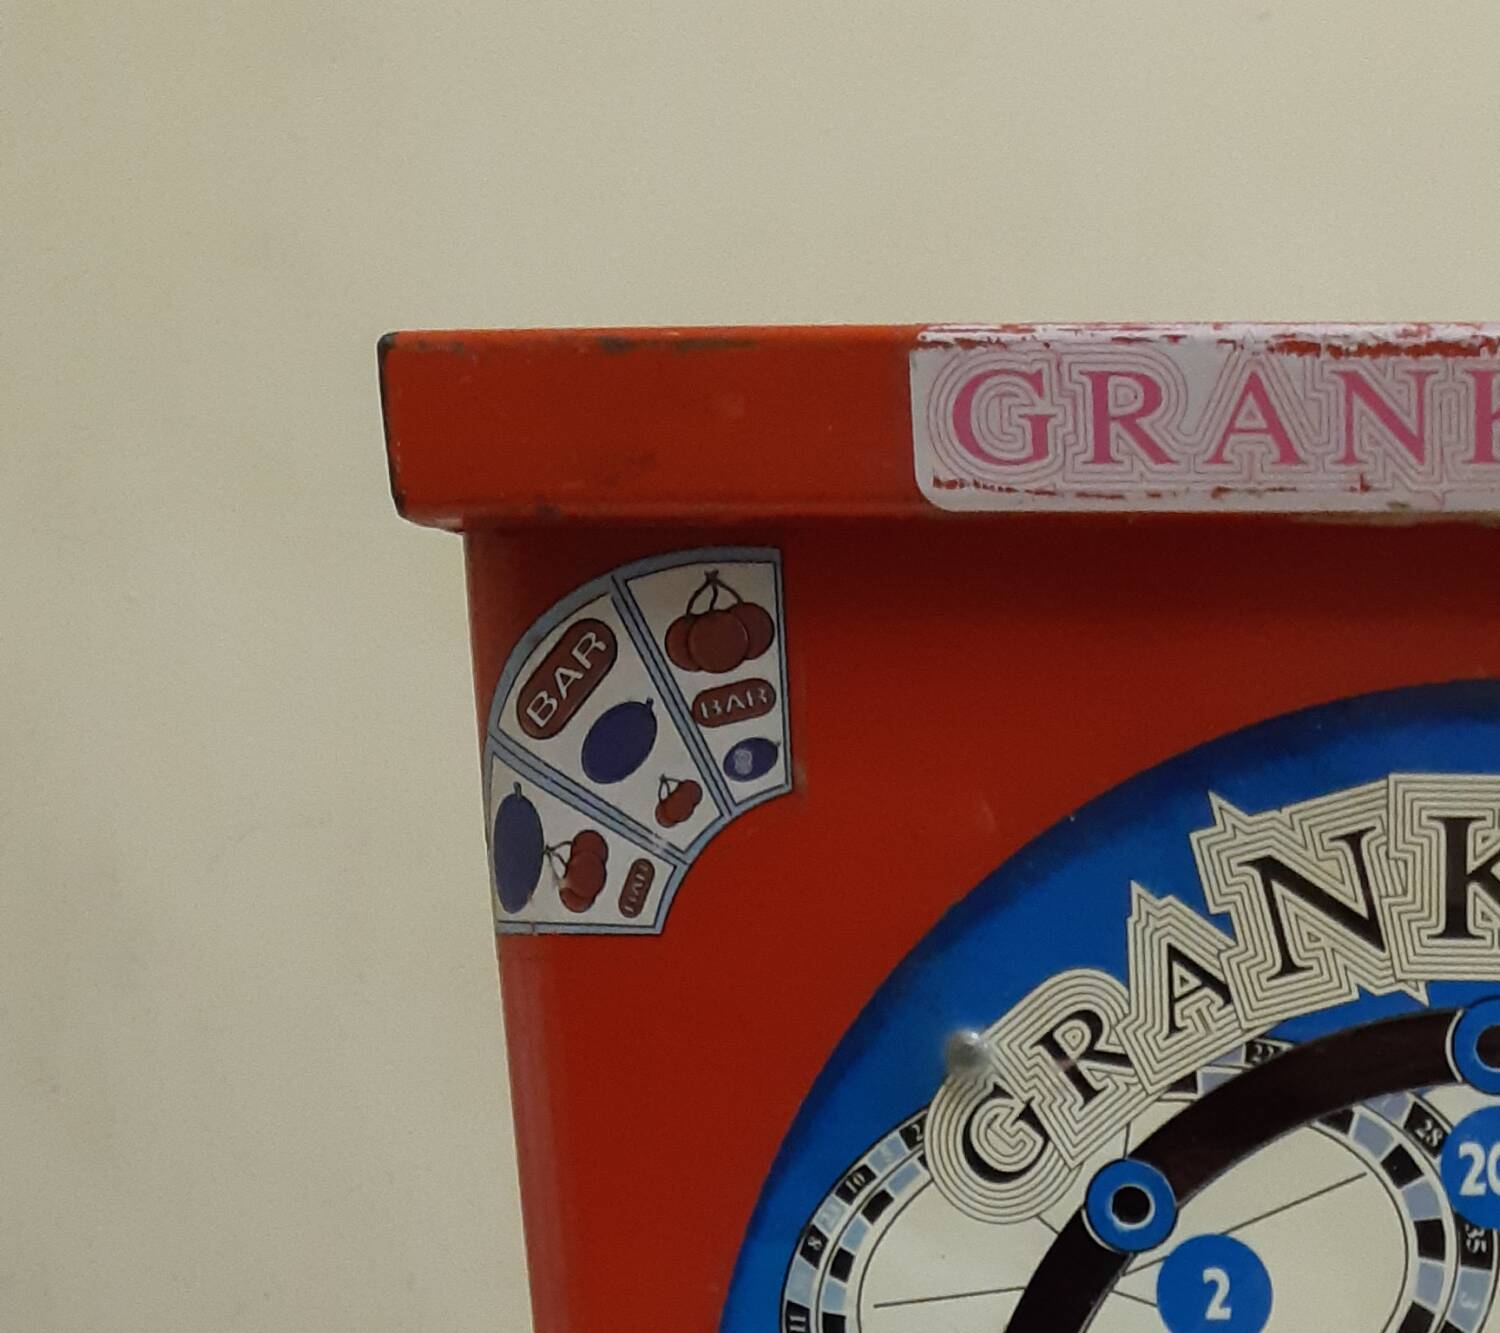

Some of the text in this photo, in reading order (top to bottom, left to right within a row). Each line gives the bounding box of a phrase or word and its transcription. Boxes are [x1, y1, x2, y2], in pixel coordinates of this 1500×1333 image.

[525, 631, 607, 728] BAR
[701, 688, 769, 721] BAR
[1415, 1119, 1443, 1147] 28
[845, 1172, 866, 1194] 10
[807, 1236, 823, 1251] 8
[1465, 1222, 1487, 1254] 35
[1203, 1266, 1232, 1321] 2
[789, 1315, 807, 1333] 11
